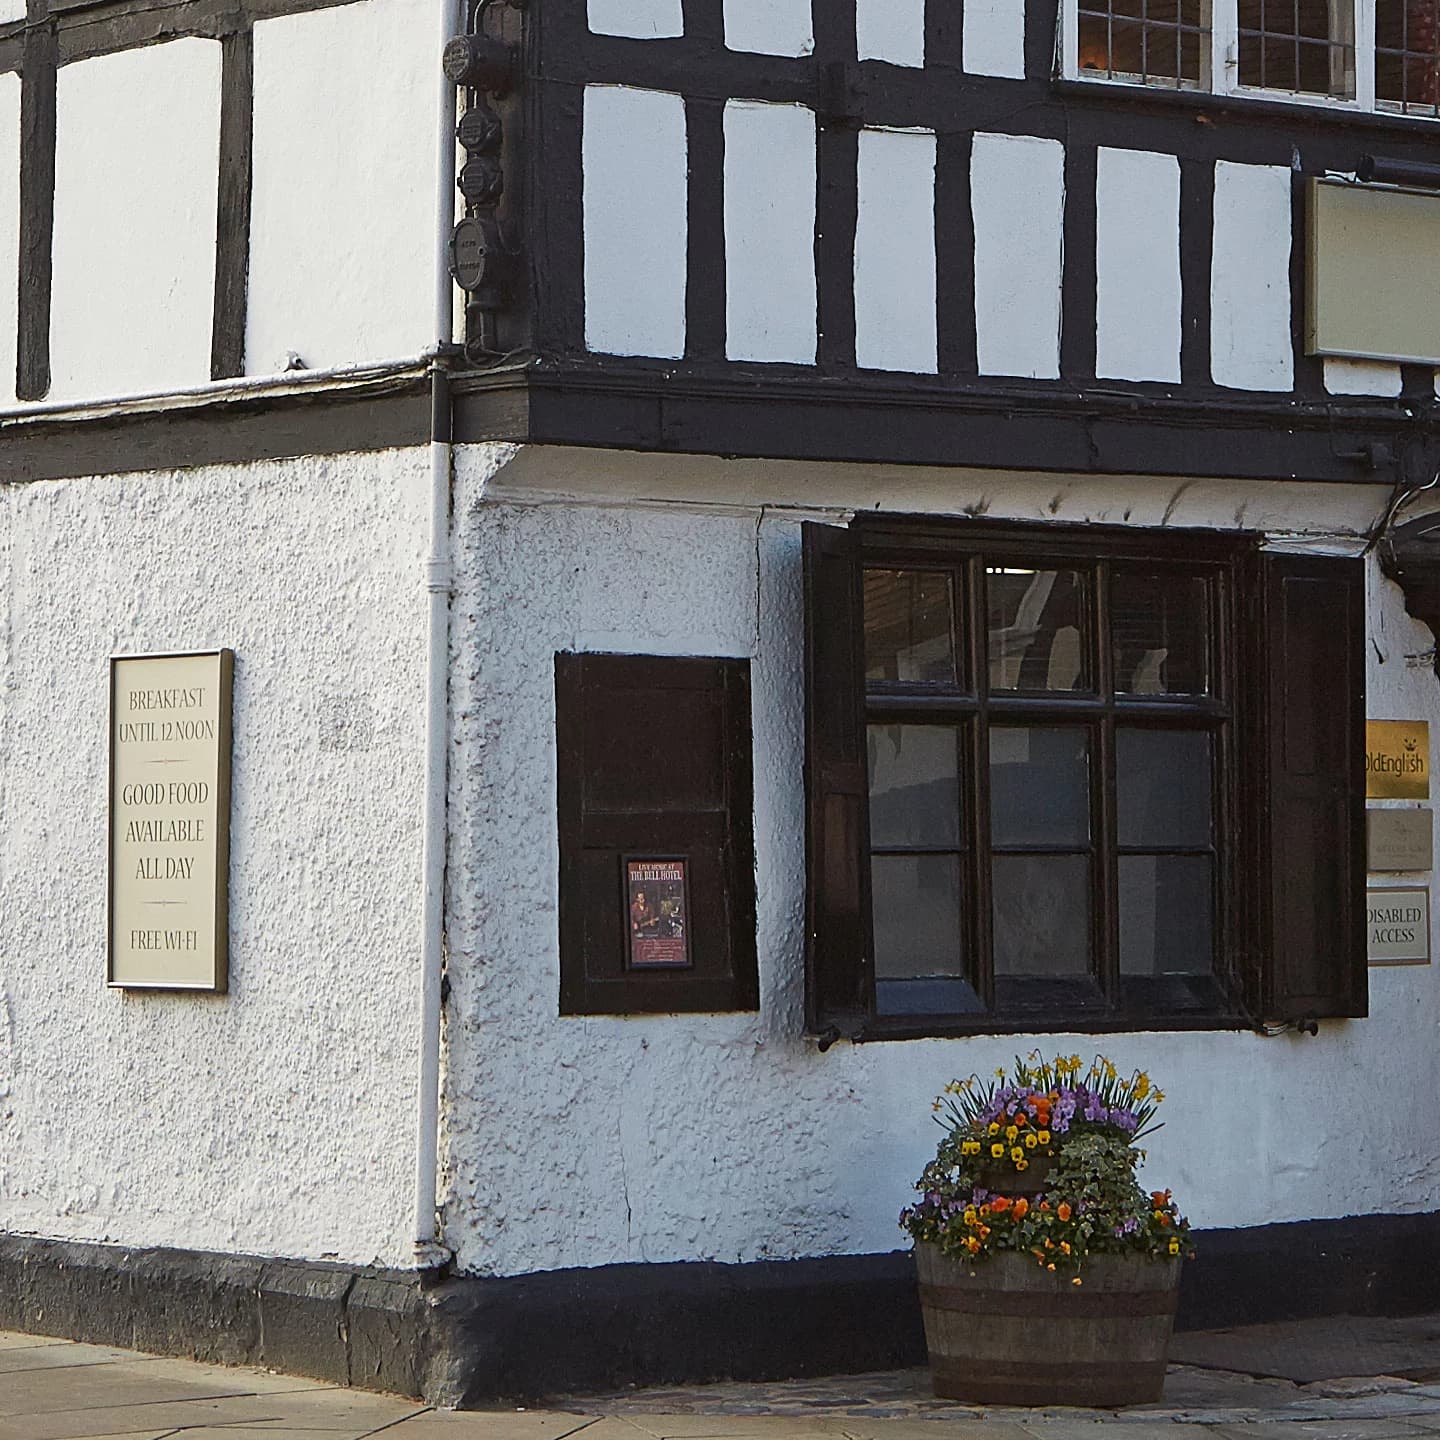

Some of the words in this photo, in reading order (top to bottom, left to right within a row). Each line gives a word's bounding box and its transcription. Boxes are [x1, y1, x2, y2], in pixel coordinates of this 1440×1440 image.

[129, 688, 205, 711] BREAKFAST
[119, 722, 158, 743] UNTIL
[161, 722, 173, 741] 12
[175, 719, 214, 741] NOON
[122, 783, 165, 806] GOOD
[169, 782, 208, 805] FOOD
[125, 820, 204, 842] AVAILABLE
[136, 857, 162, 879] ALL
[166, 857, 194, 879] DAY
[1367, 908, 1421, 923] DISABLED
[131, 930, 161, 950] FREE
[1372, 928, 1415, 943] ACCESS
